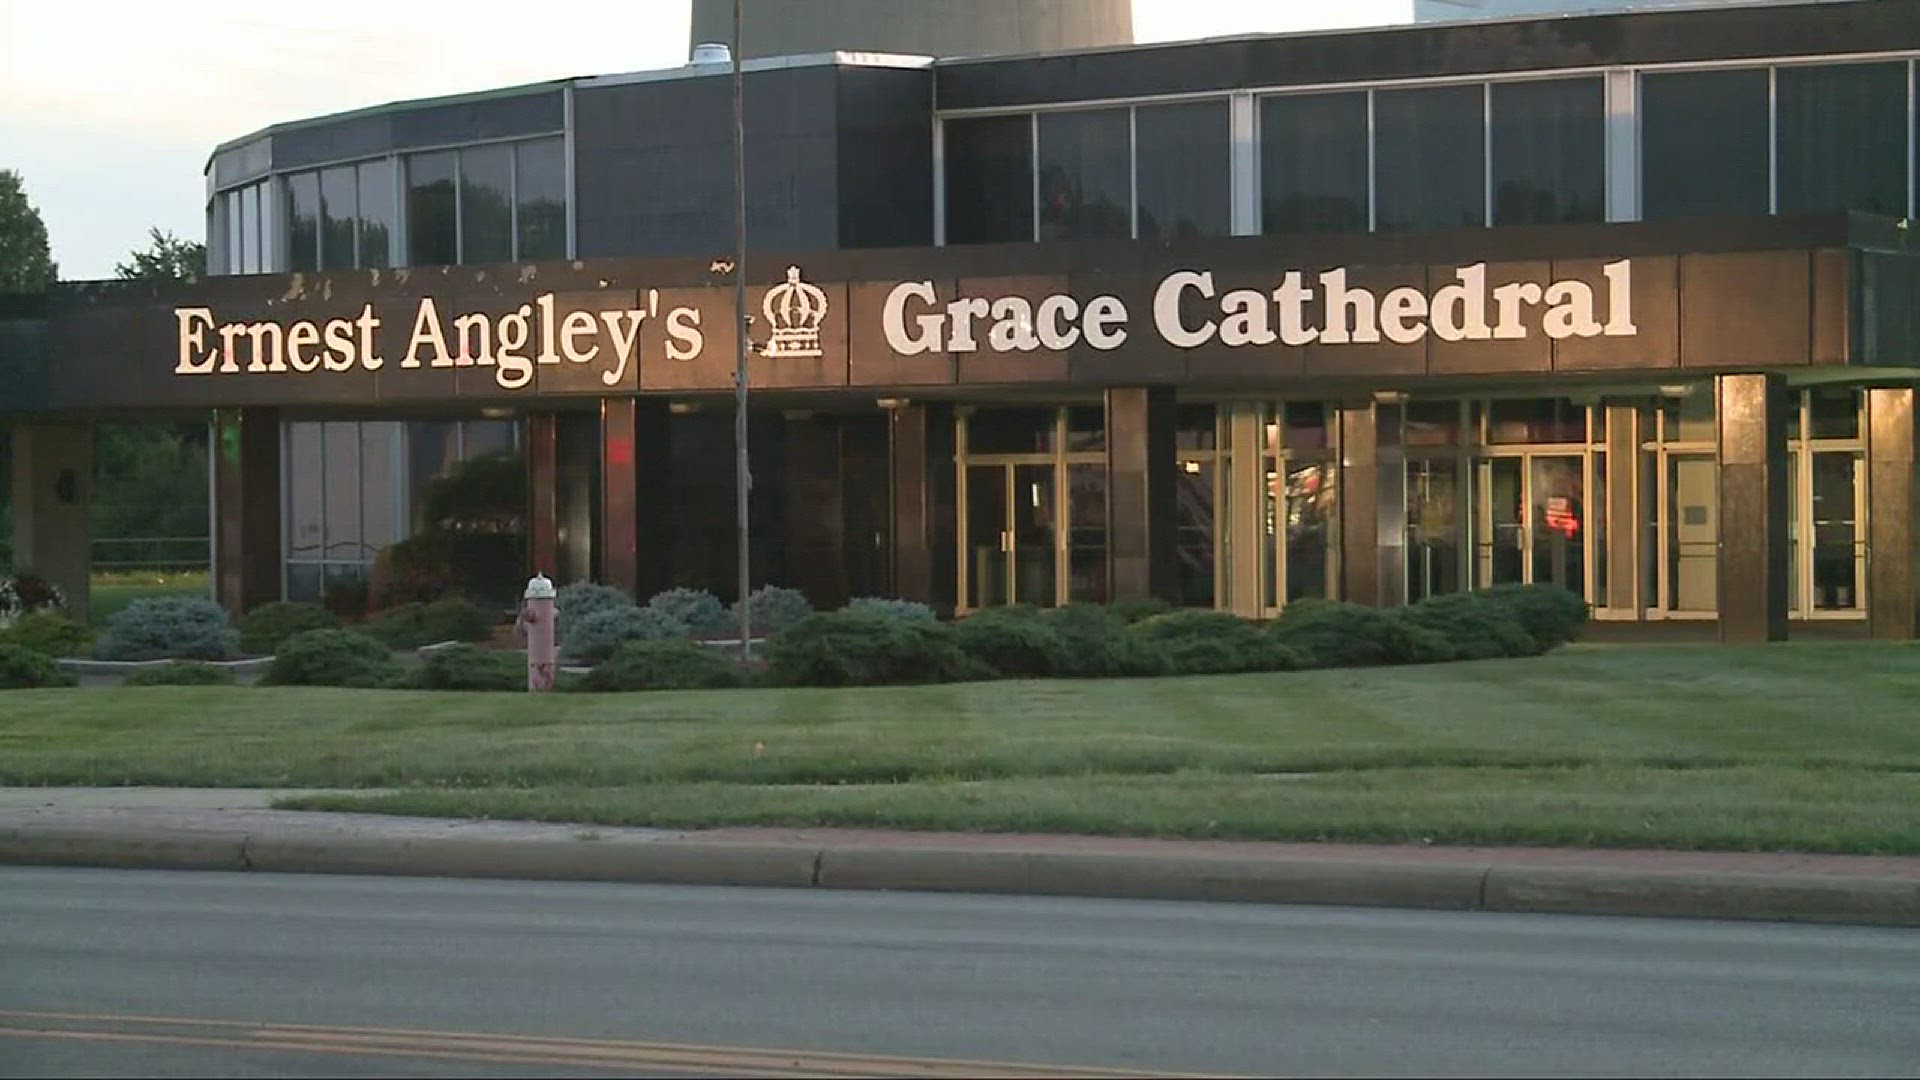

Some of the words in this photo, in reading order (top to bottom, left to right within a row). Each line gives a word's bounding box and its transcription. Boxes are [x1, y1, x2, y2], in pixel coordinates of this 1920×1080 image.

[174, 305, 384, 374] Ernest
[400, 289, 702, 389] Angley's
[882, 280, 1128, 355] Grace
[1153, 259, 1637, 347] Cathedral
